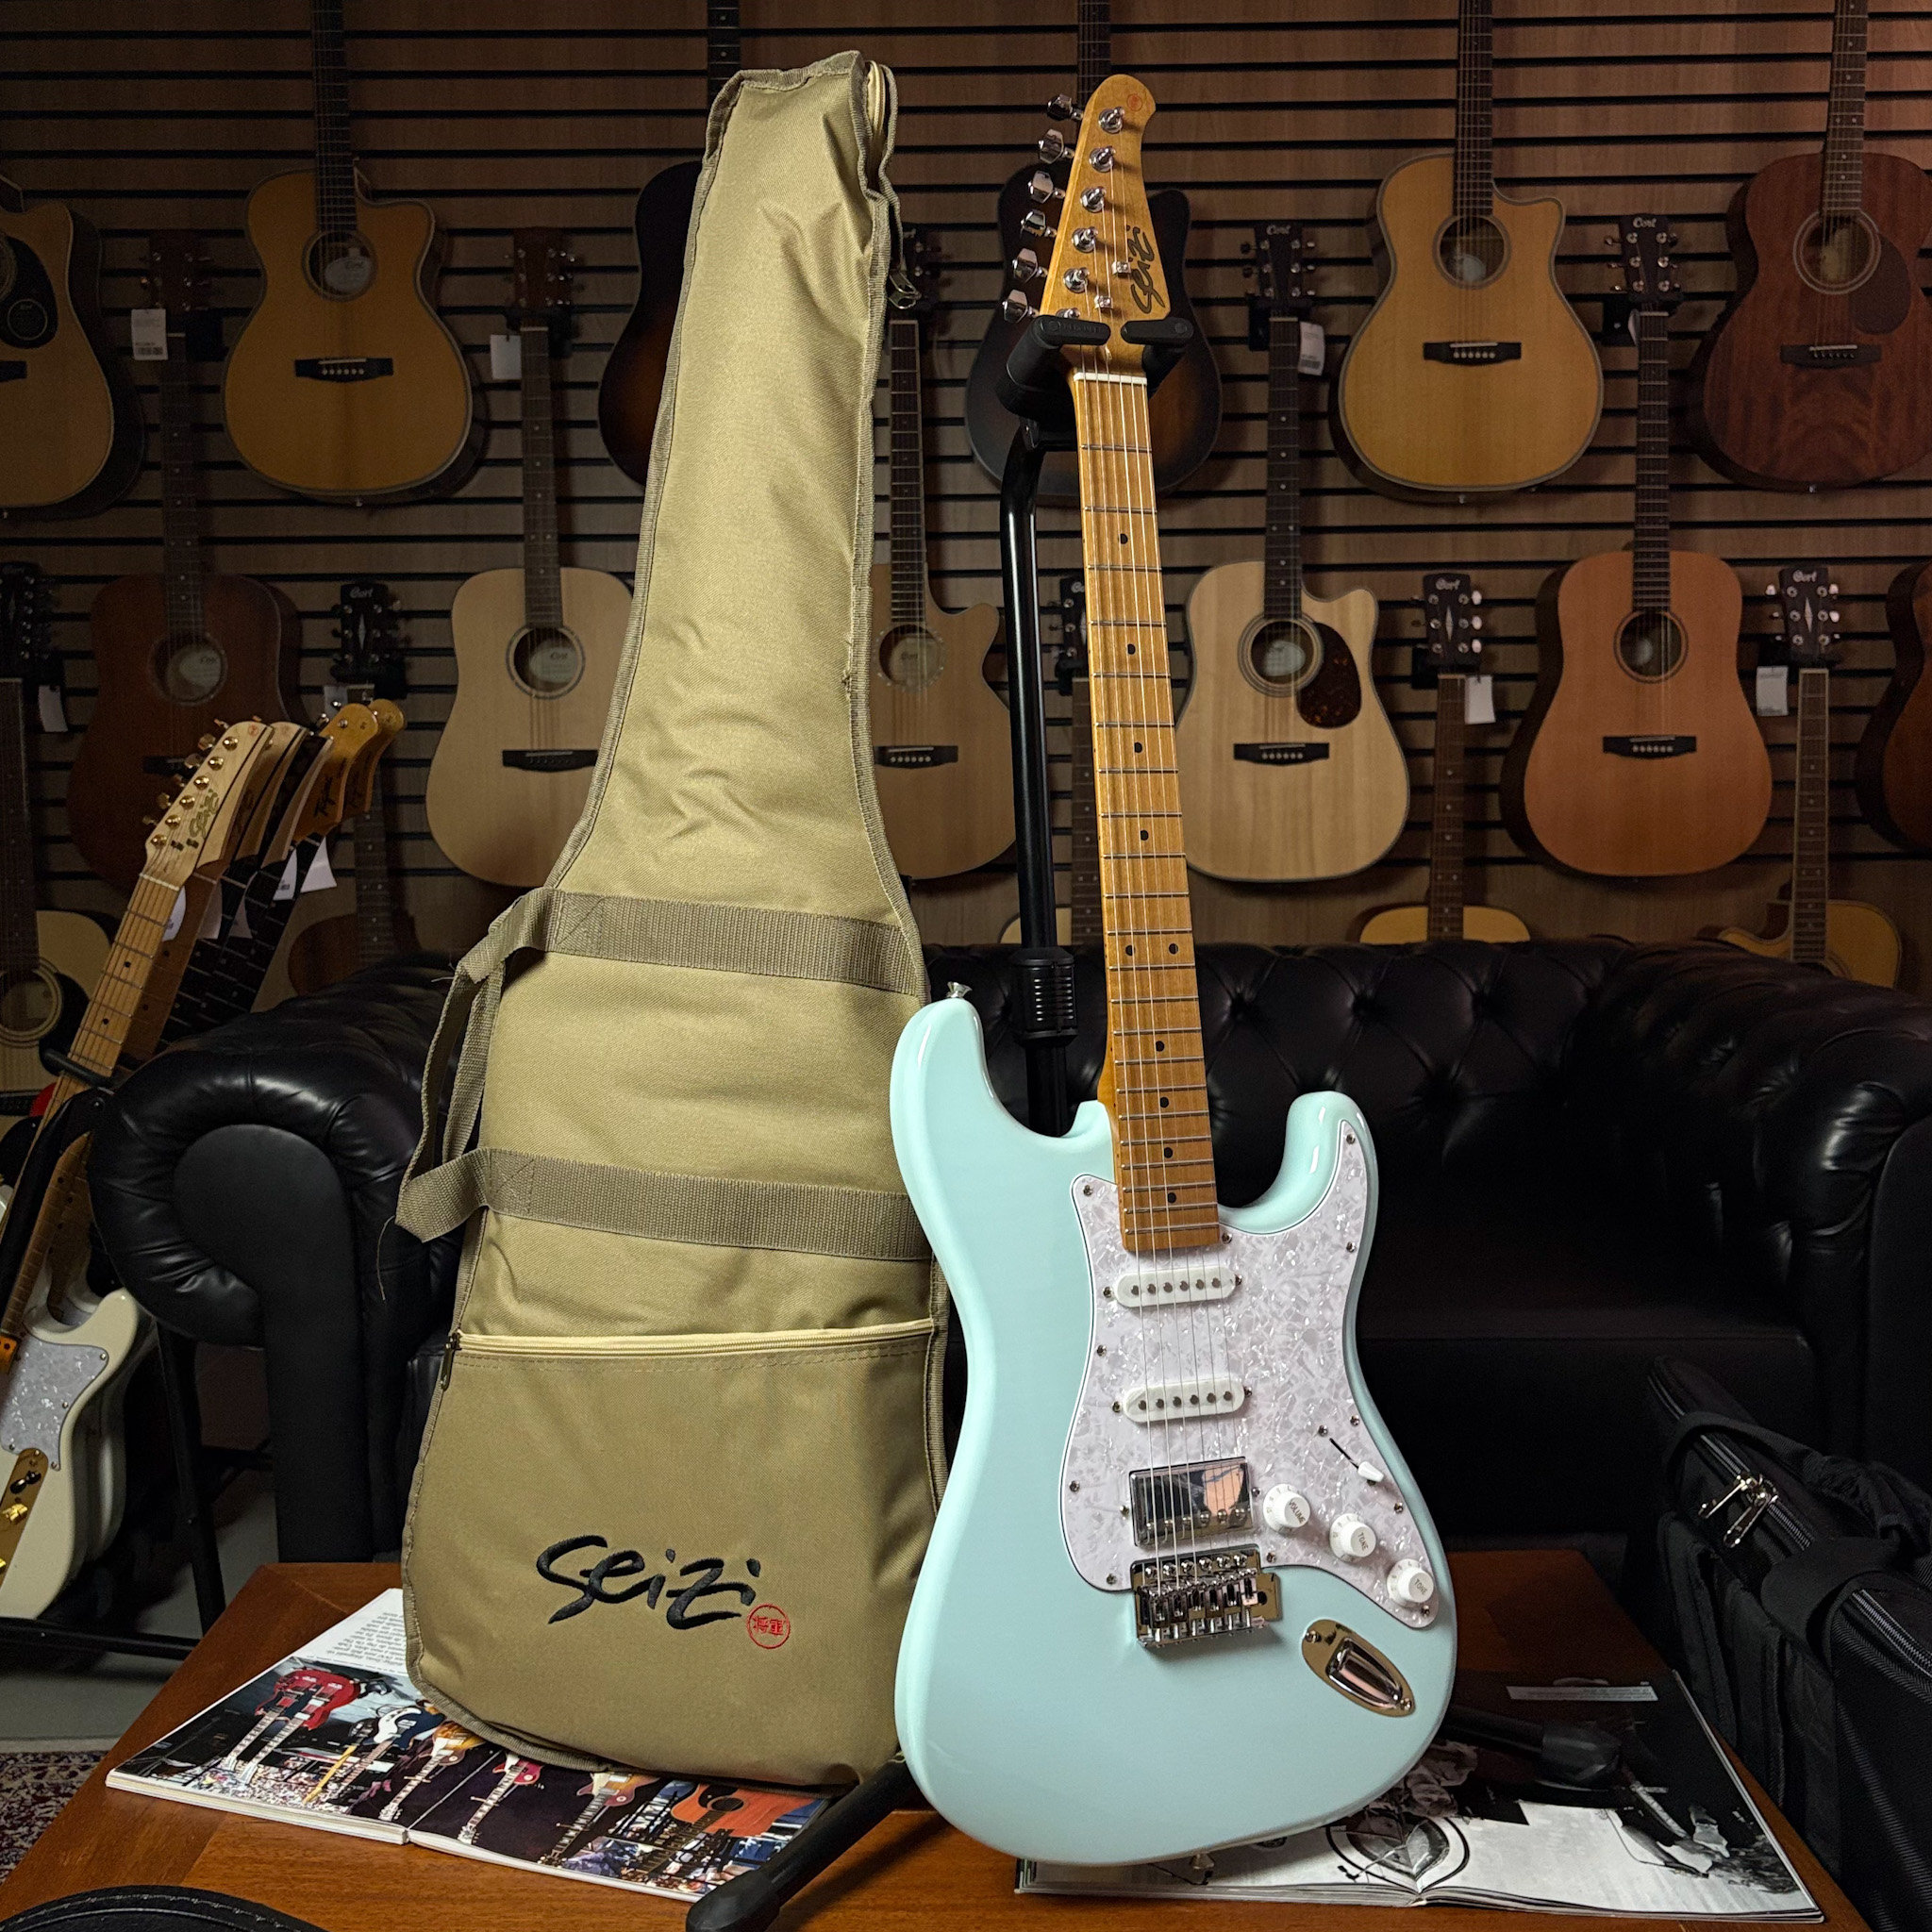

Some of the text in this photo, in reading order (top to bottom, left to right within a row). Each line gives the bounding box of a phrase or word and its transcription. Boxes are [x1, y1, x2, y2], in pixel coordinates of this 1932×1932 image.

[1289, 1498, 1307, 1524] VOLUME
[1357, 1531, 1369, 1552] TONE
[537, 1535, 760, 1630] Seizi
[1414, 1578, 1428, 1596] TONE
